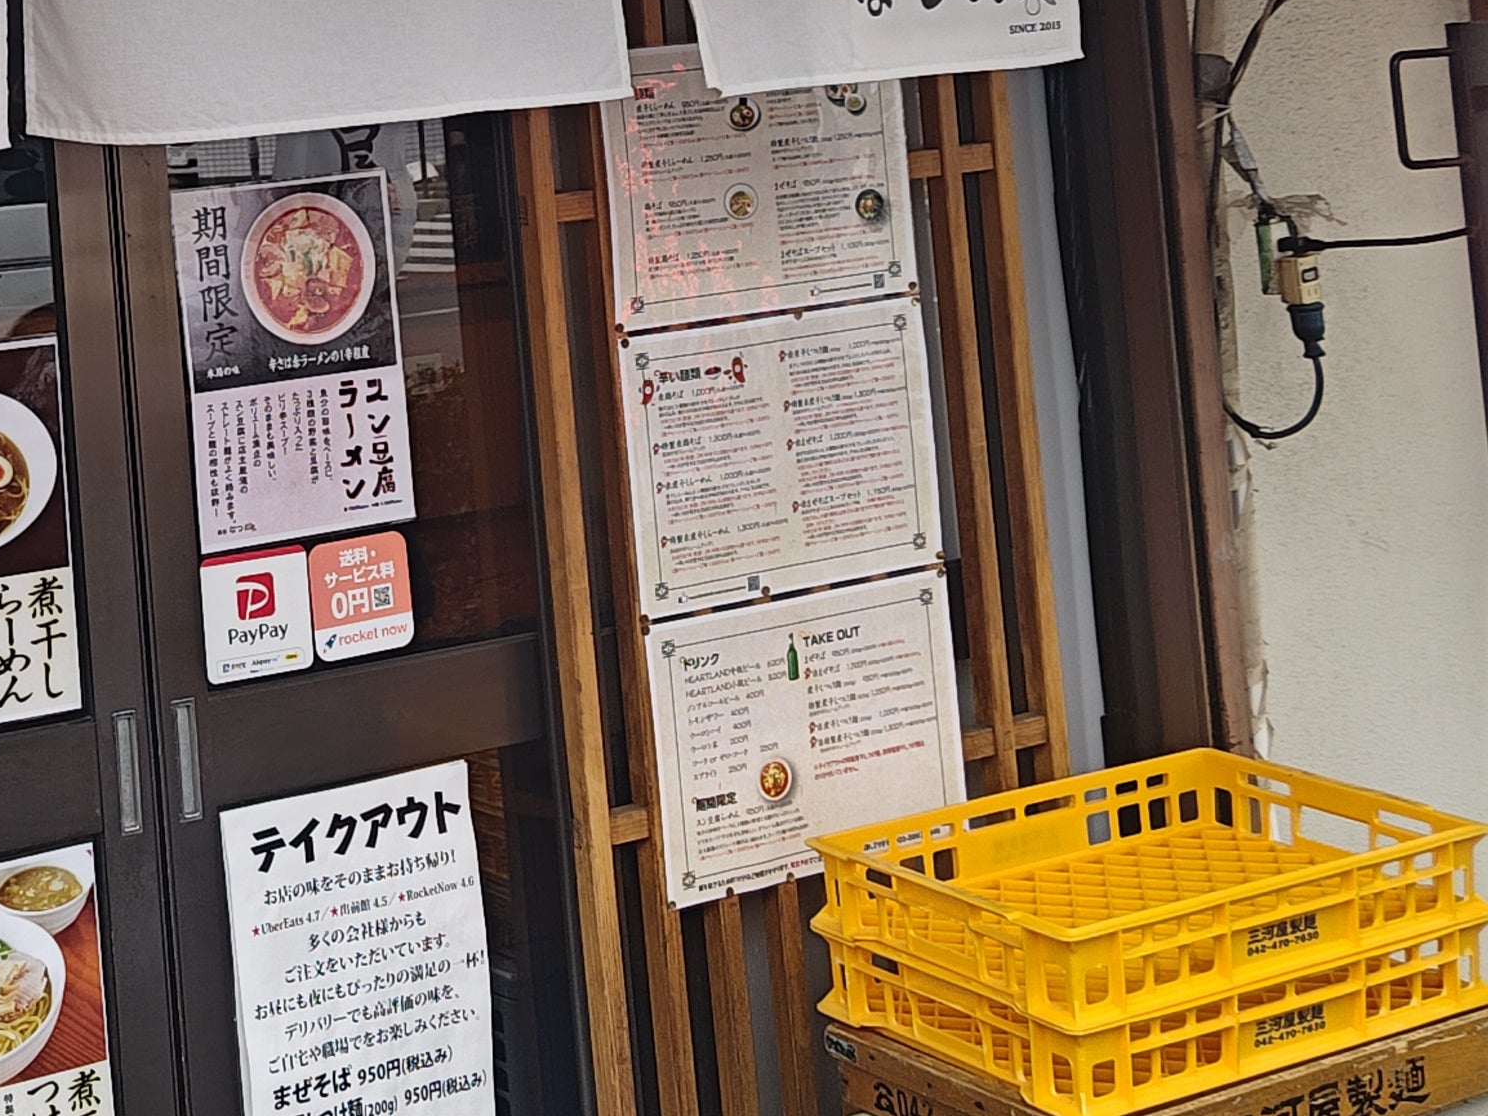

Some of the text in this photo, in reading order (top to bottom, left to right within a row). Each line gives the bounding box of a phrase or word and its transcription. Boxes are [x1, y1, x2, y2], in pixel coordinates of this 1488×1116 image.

[1009, 21, 1061, 34] SINCE 2015
[190, 205, 239, 362] 期間限定
[338, 379, 366, 500] ラーメン
[366, 378, 396, 498] スン豆腐
[324, 560, 395, 589] サービス料
[331, 587, 370, 620] 0円
[28, 576, 68, 699] 煮干し
[228, 623, 288, 646] PayPay
[338, 624, 408, 646] rocket now
[803, 626, 861, 648] TAKE OUT
[683, 653, 720, 672] ドリンク
[250, 791, 461, 873] テイクアウト
[261, 913, 305, 935] UberEats
[406, 879, 459, 901] RocketNow
[308, 910, 427, 952] 多くの会社様からも
[273, 1065, 353, 1111] まぜそば
[1244, 1056, 1431, 1116] 河屋製麺
